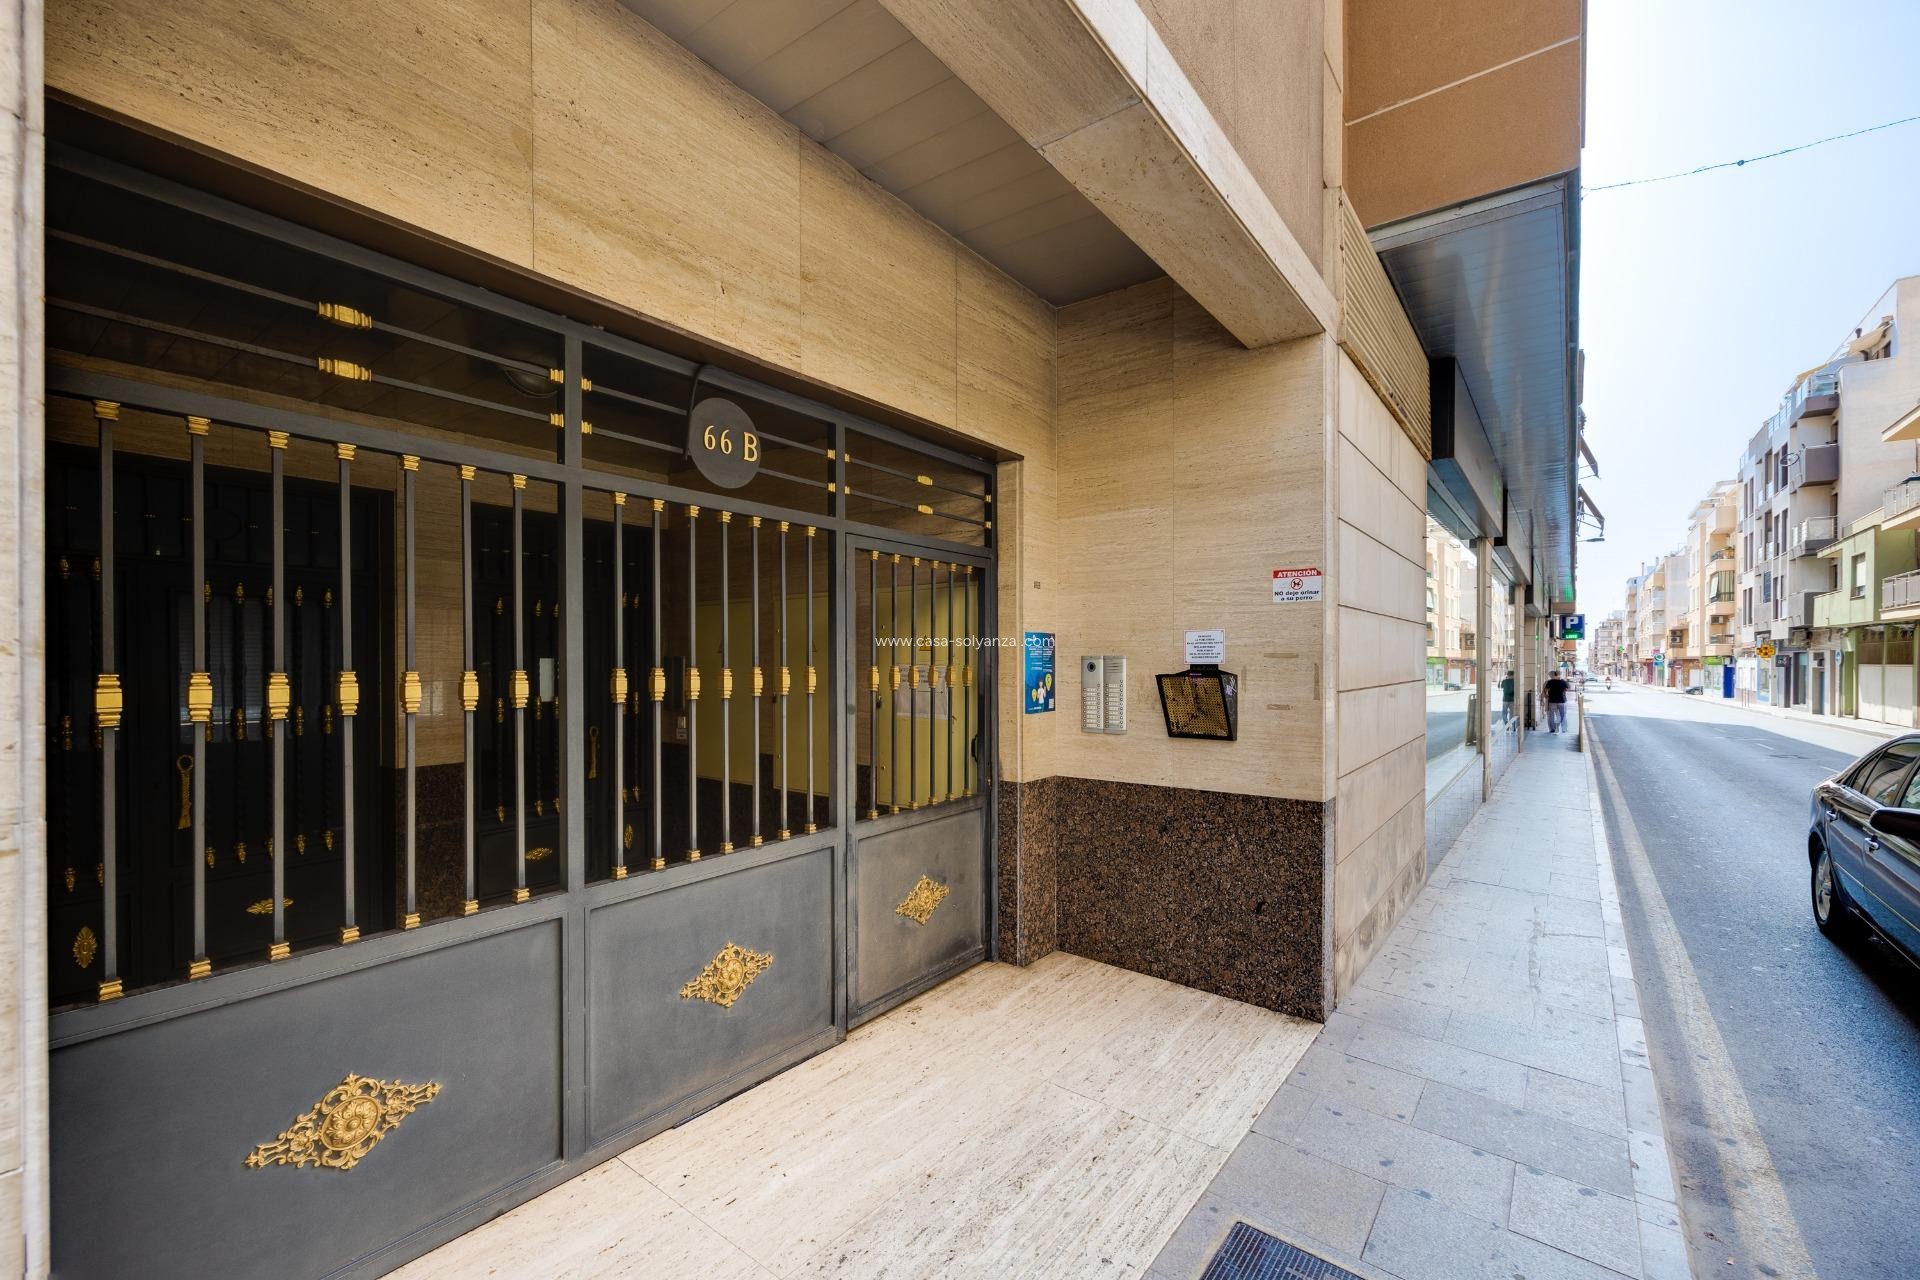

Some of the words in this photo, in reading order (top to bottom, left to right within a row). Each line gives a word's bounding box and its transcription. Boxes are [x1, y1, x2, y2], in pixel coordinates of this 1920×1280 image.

[703, 425, 732, 454] 66
[743, 431, 758, 462] B
[1277, 569, 1318, 578] ATENCIÓN
[1565, 616, 1579, 629] P
